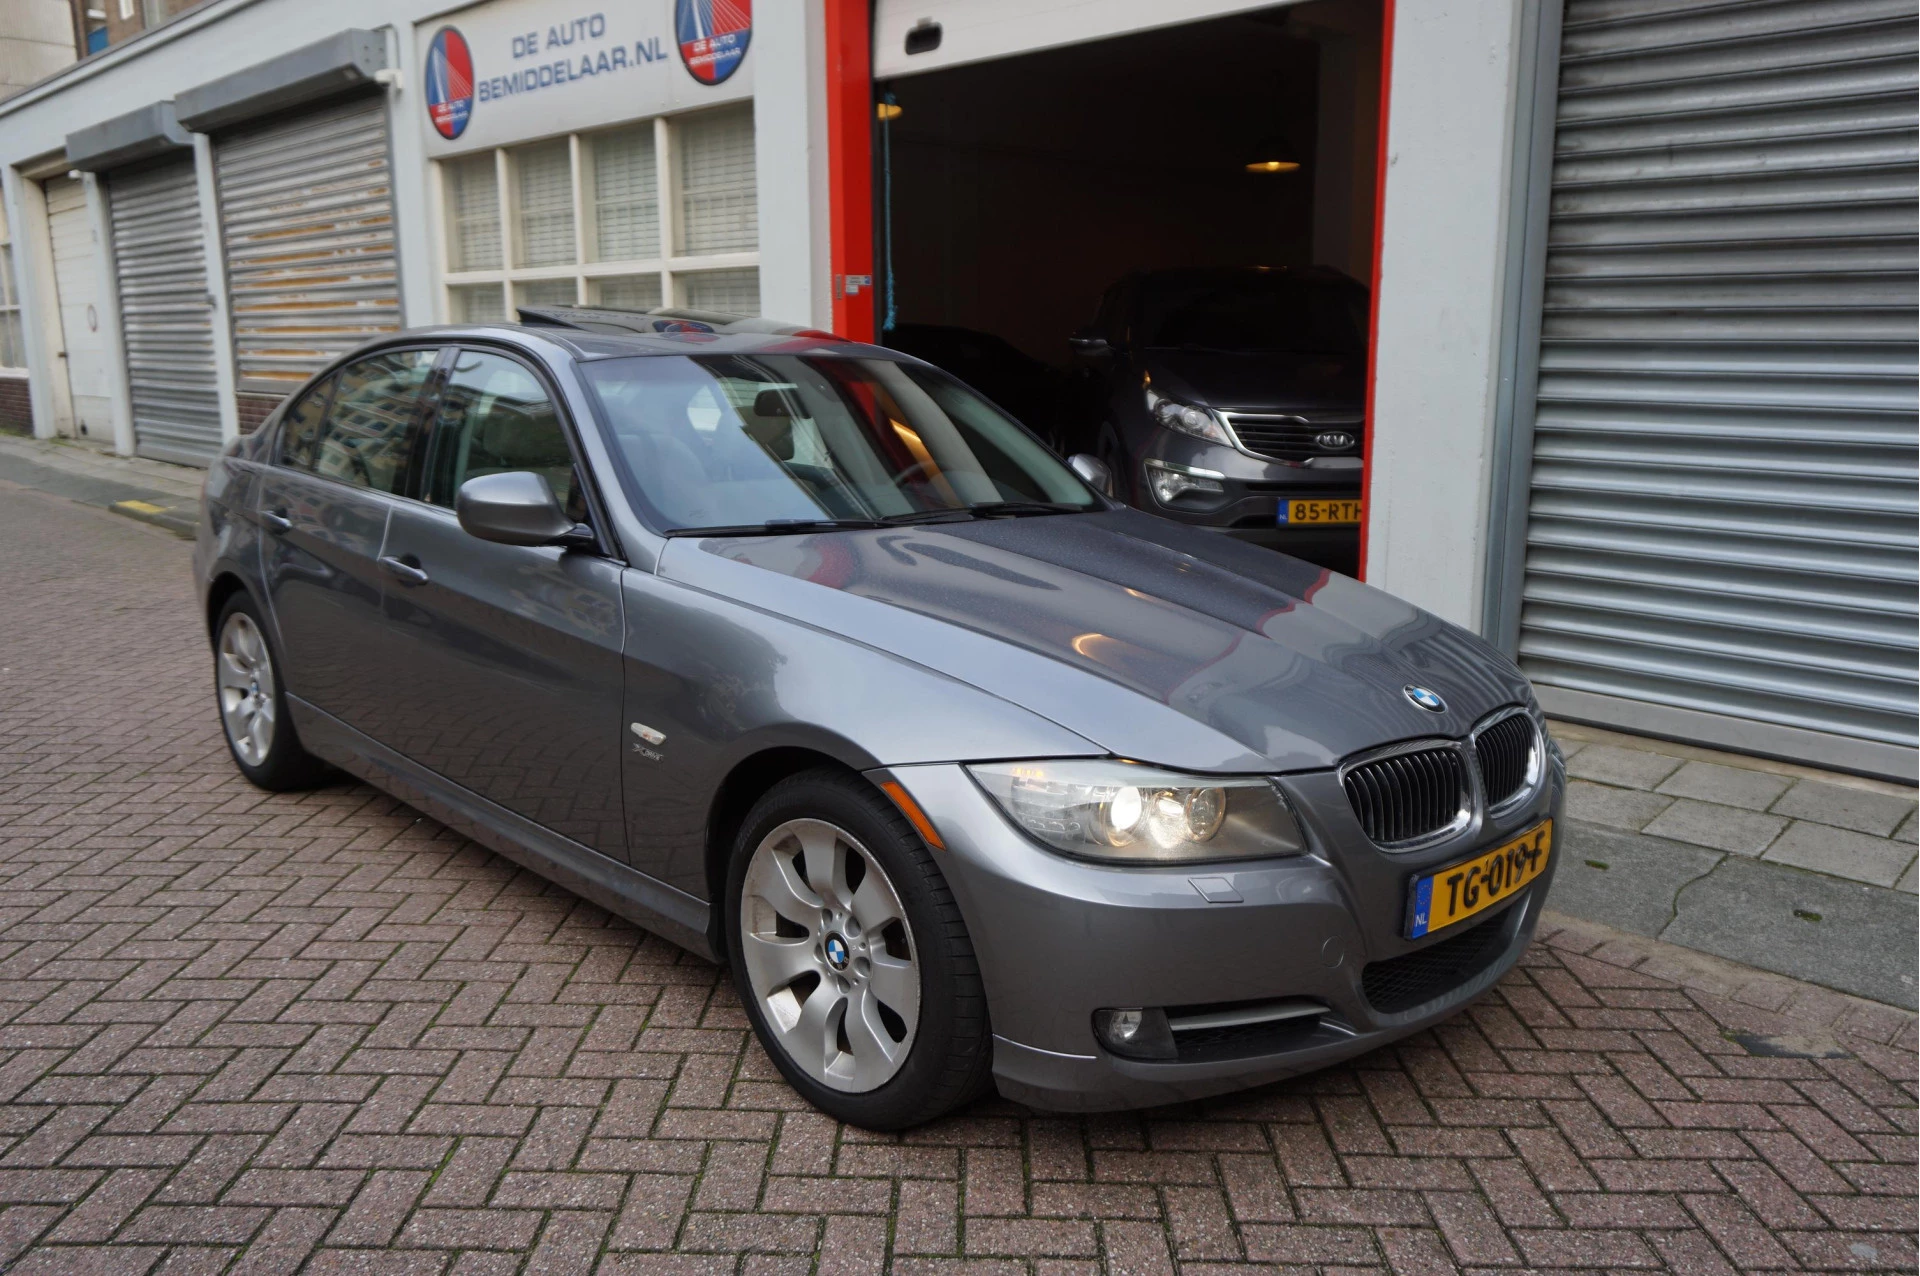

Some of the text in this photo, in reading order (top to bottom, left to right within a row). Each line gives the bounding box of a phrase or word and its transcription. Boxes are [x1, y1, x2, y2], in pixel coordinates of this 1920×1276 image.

[512, 13, 606, 59] DE AUTO
[693, 33, 735, 53] DE AUTO
[478, 37, 668, 102] BEMIDDELAAR.NL
[1446, 830, 1545, 917] TG-019-F
[1415, 912, 1427, 927] NL
